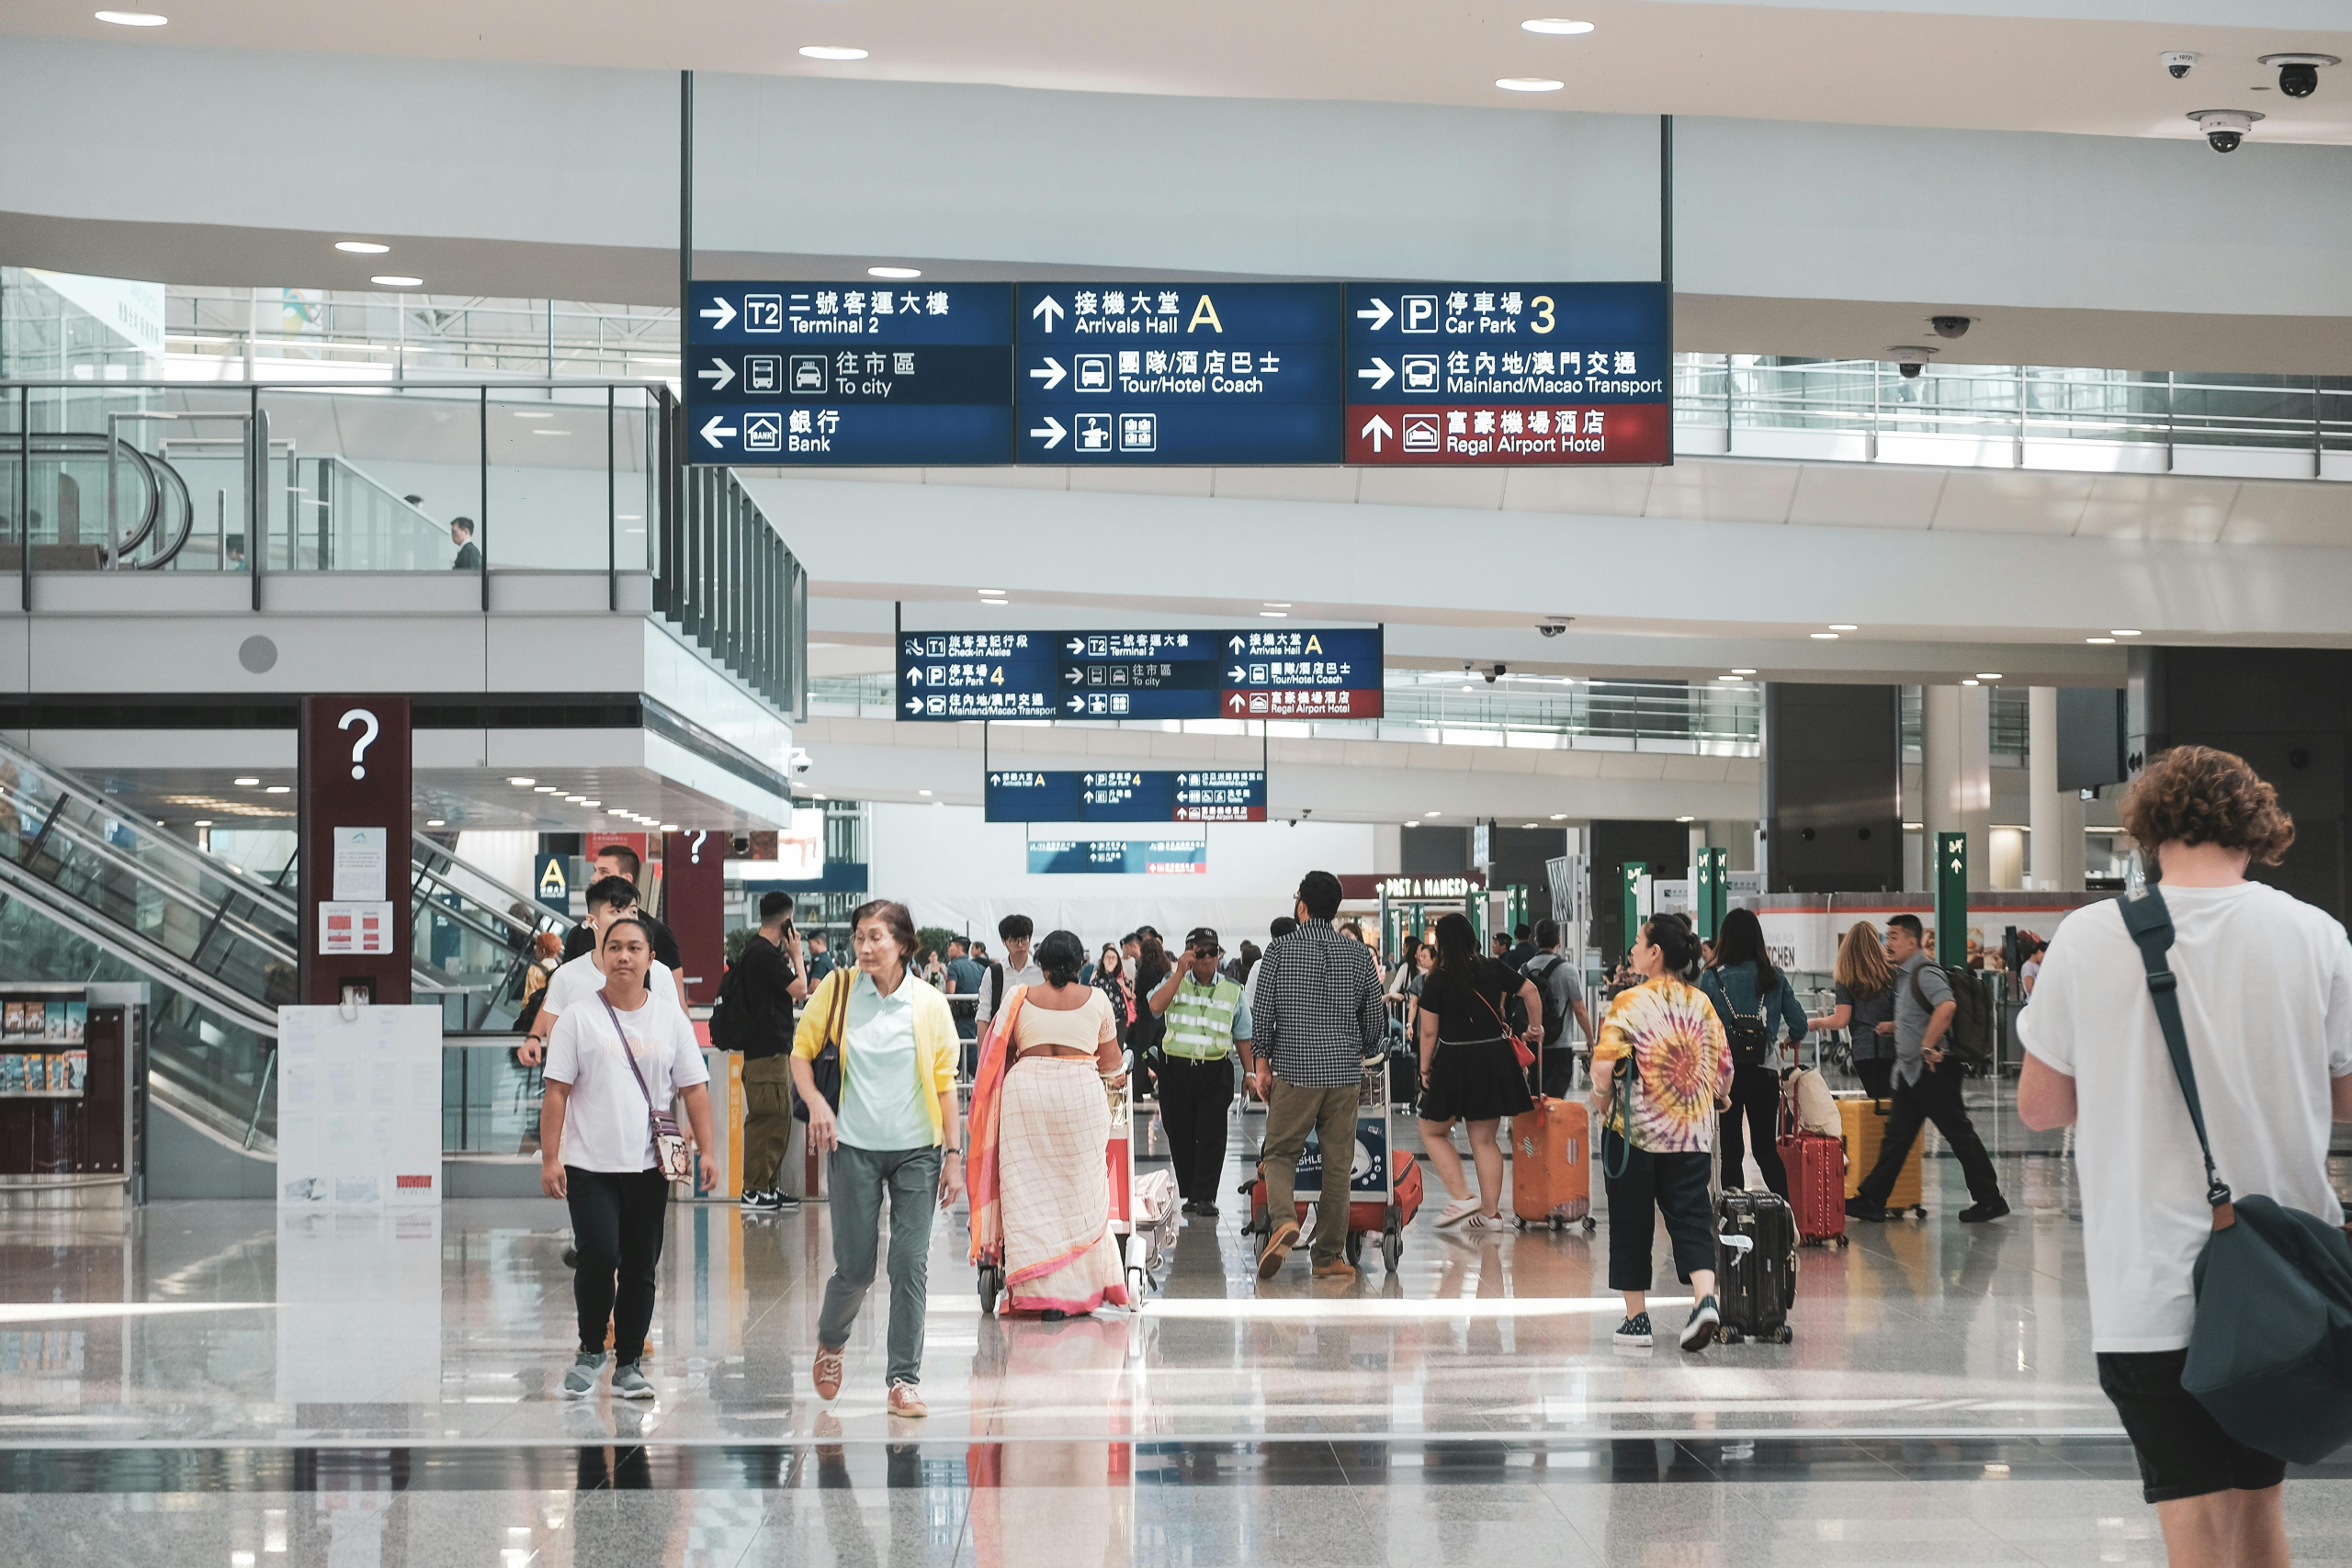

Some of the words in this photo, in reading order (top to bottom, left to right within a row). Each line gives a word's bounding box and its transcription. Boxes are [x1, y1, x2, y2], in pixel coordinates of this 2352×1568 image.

[789, 290, 950, 315] 二號客運大樓
[1075, 290, 1180, 315] 接機大堂
[1445, 291, 1523, 315] 停車場
[748, 302, 779, 325] T2
[1187, 294, 1223, 333] A
[1409, 299, 1432, 329] P
[1530, 295, 1555, 333] 3
[789, 316, 863, 333] Terminal
[868, 317, 879, 333] 2
[1075, 317, 1141, 333] Arrivals
[1146, 317, 1178, 333] Hall
[1445, 318, 1475, 333] Car
[1480, 317, 1517, 333] Park
[835, 351, 915, 376] 往市區
[1118, 350, 1280, 375] 團隊/酒店巴士
[1447, 351, 1636, 375] 往內地/澳門交通
[835, 378, 856, 394] To
[862, 378, 892, 398] city
[1119, 376, 1205, 393] Tour/Hotel
[1211, 376, 1263, 393] Coach
[1447, 377, 1583, 394] Mainland/Macao
[1585, 378, 1663, 396] Transport
[789, 409, 840, 434] 銀行
[1447, 410, 1605, 434] 富豪機場酒店
[789, 435, 831, 451] Bank
[1447, 435, 1492, 456] Regal
[1497, 435, 1555, 456] Airport
[1562, 435, 1605, 452] Hotel
[929, 640, 944, 653] T1
[1090, 639, 1105, 652] T2
[1250, 633, 1302, 646] 接機大堂
[1304, 634, 1323, 655] A
[948, 648, 984, 657] Check-in
[986, 648, 1011, 657] Aisles
[1110, 646, 1147, 656] Terminal
[1148, 647, 1155, 656] 2
[1250, 646, 1282, 655] Arrivals
[1283, 646, 1301, 655] Hall
[931, 668, 944, 684] P
[949, 663, 988, 677] 停車場
[989, 665, 1005, 686] 4
[1132, 663, 1171, 676] 往市區
[948, 677, 963, 686] Car
[966, 677, 984, 686] Park
[1132, 677, 1143, 685] To
[1145, 677, 1160, 687] city
[1272, 674, 1315, 684] Tour/Hotel
[1317, 674, 1342, 684] Coach
[949, 705, 1017, 716] Mainland/Macao
[1017, 705, 1057, 716] Transport
[1271, 704, 1294, 715] Regal
[1296, 704, 1325, 715] Airport
[1328, 704, 1350, 713] Hotel
[1034, 773, 1046, 786] A
[1132, 773, 1141, 786] 4
[539, 858, 566, 887] A
[1386, 878, 1411, 897] PRET
[1413, 878, 1421, 897] A
[603, 1038, 661, 1056] FATASY
